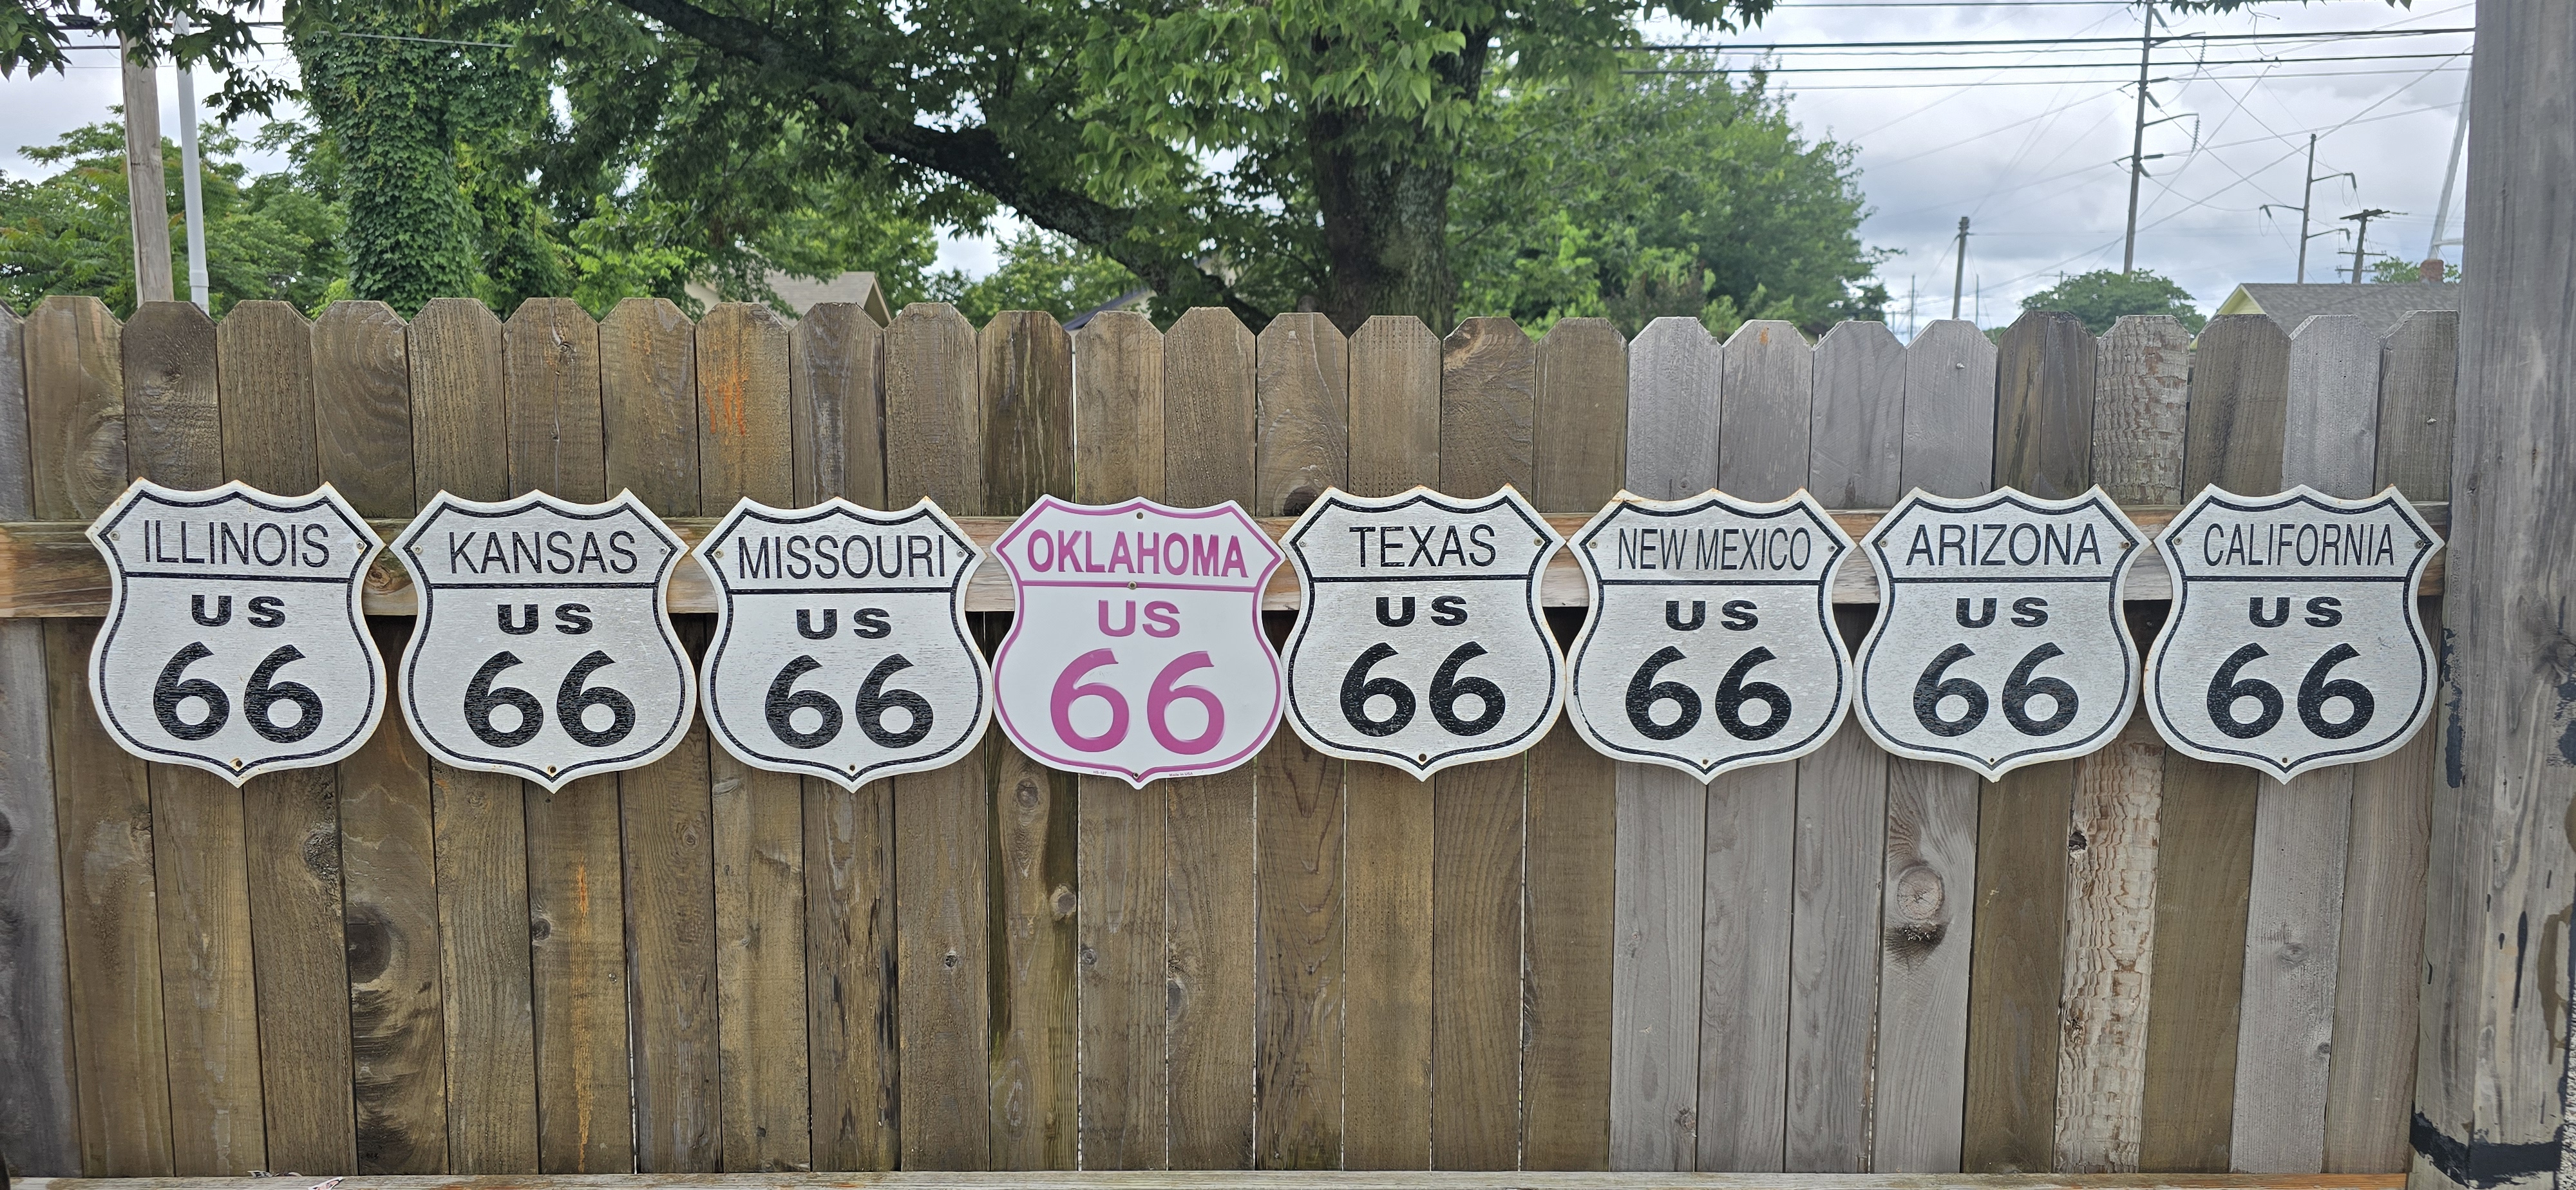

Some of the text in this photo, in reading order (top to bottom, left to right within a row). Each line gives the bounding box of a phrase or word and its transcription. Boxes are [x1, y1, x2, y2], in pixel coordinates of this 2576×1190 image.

[145, 520, 329, 567] ILLINOIS
[450, 531, 637, 574] KANSAS
[739, 535, 944, 579] MISSOURI
[1027, 529, 1247, 577] OKLAHOMA
[1349, 524, 1495, 567] TEXAS
[1619, 527, 1810, 571] NEW MEXICO
[1906, 524, 2101, 565] ARIZONA
[2204, 524, 2394, 566] CALIFORNIA
[192, 595, 285, 628] US
[498, 603, 592, 635] US
[797, 609, 891, 639] US
[1098, 600, 1180, 638] US
[1376, 596, 1467, 627] US
[1666, 600, 1758, 631] US
[1956, 598, 2048, 628] US
[2249, 597, 2342, 628] US
[153, 642, 323, 743] 66
[464, 650, 635, 748] 66
[765, 654, 933, 749] 66
[1050, 648, 1224, 755] 66
[1340, 641, 1505, 737] 66
[1625, 646, 1791, 741] 66
[1913, 643, 2078, 737] 66
[2207, 643, 2374, 739] 66
